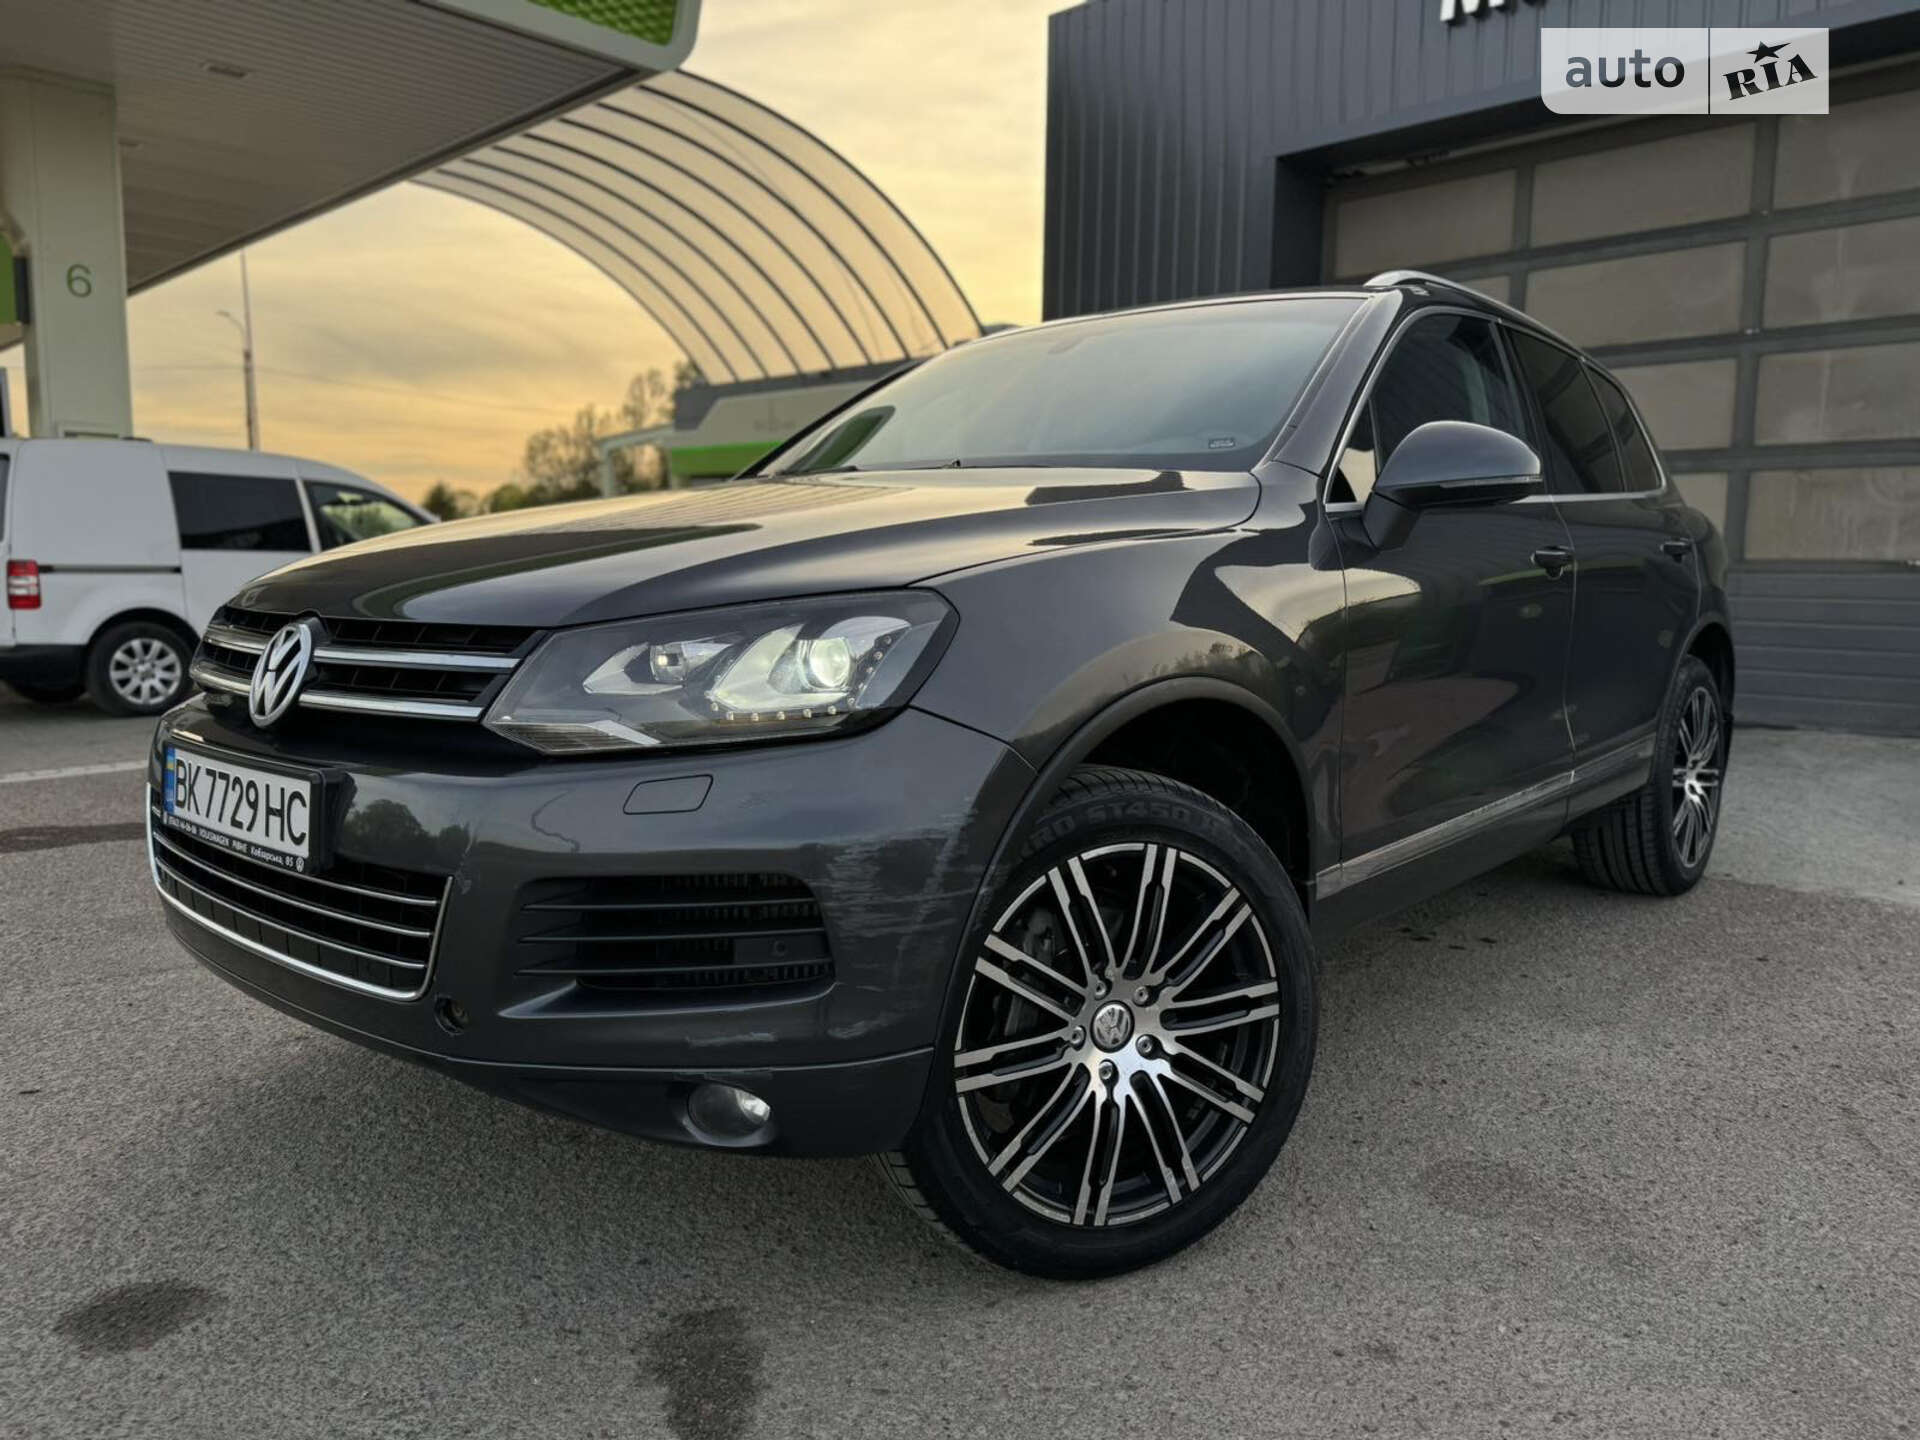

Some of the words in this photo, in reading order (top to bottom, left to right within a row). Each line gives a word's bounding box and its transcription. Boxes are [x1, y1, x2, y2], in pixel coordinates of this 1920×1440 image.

[66, 264, 92, 297] 6
[175, 758, 201, 816] BK
[205, 768, 259, 832] 7729
[265, 783, 307, 846] HC
